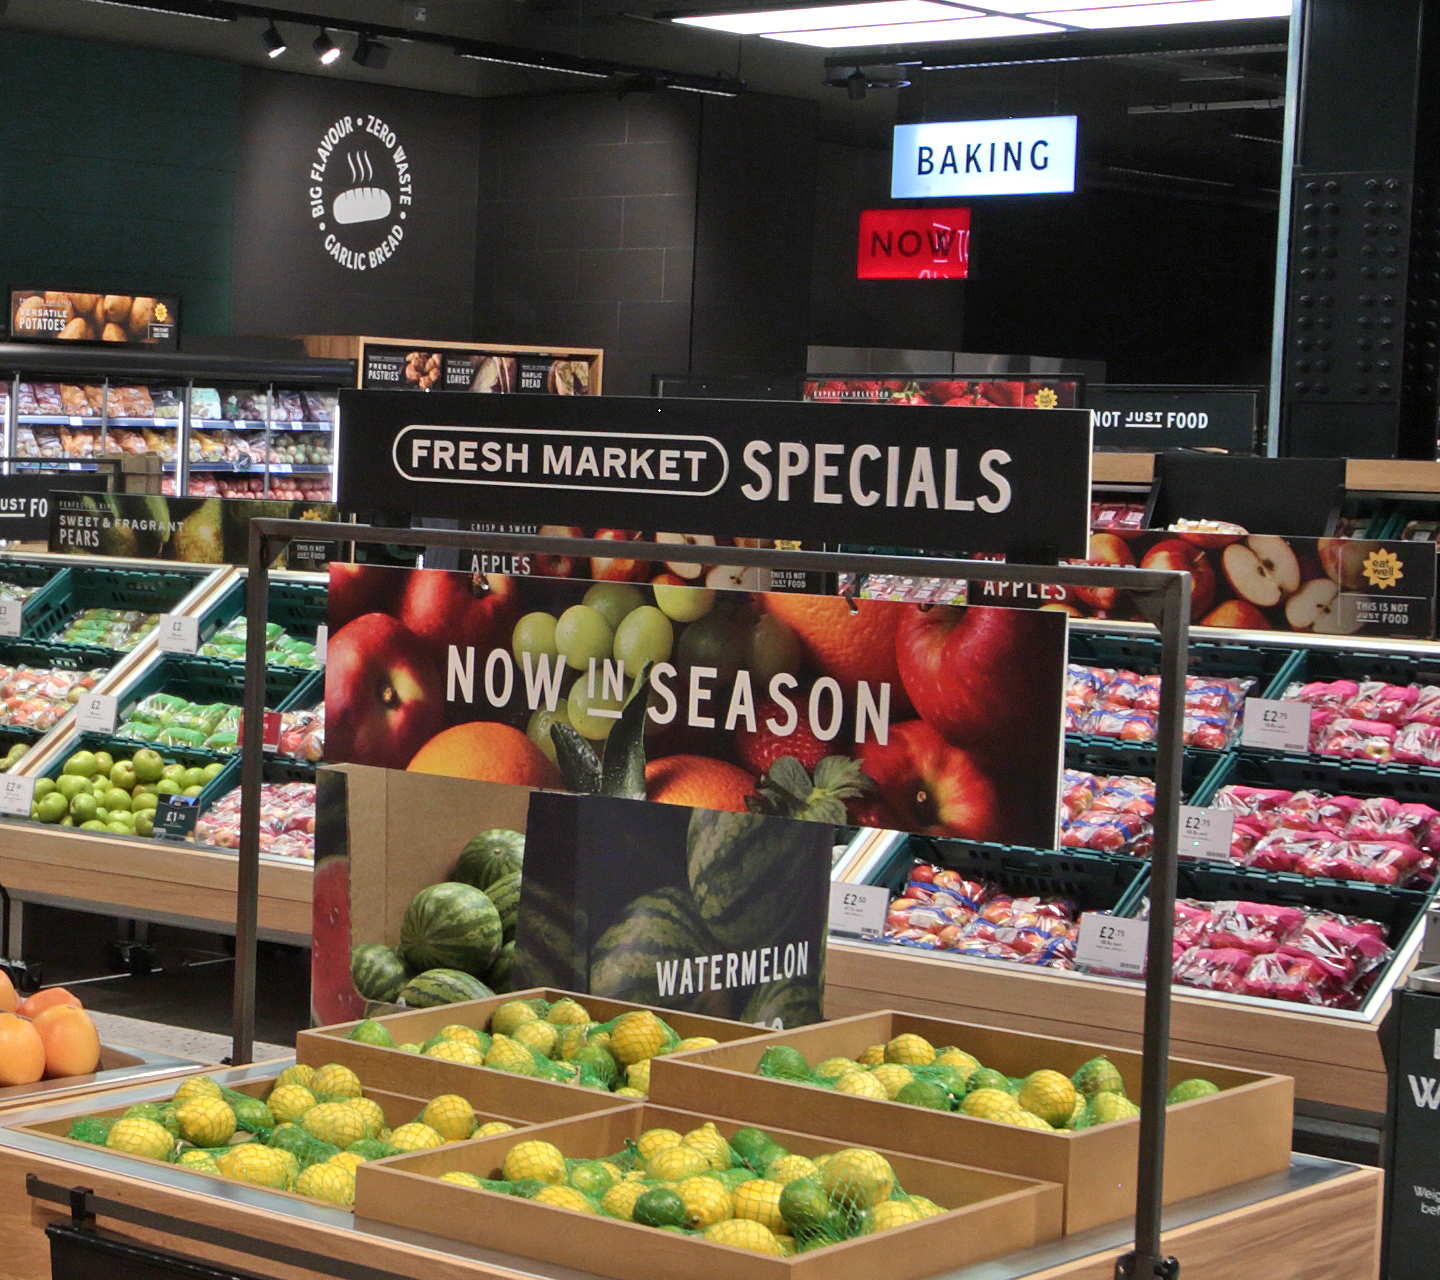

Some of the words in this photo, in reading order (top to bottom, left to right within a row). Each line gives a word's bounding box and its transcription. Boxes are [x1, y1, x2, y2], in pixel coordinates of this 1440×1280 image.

[310, 115, 354, 182] FLAVOUR
[916, 139, 1050, 176] BAKING
[366, 114, 397, 148] ZERO
[392, 145, 412, 206] WASTE
[309, 186, 325, 219] BIG
[324, 234, 367, 271] GARLIC
[368, 224, 404, 269] BREAD
[870, 228, 957, 259] NOW
[19, 308, 68, 318] VERSATILE
[19, 317, 66, 331] POTATOES
[368, 369, 400, 382] PASTRIES
[447, 374, 470, 385] LOAVES
[522, 378, 541, 389] BREAD
[1092, 411, 1120, 427] NOT
[1125, 411, 1162, 423] JUST
[1167, 411, 1208, 429] FOOD
[410, 437, 530, 475] FRESH
[542, 442, 707, 483] MARKET
[740, 438, 1013, 514] SPECIALS
[59, 515, 99, 528] SWEET
[102, 517, 113, 529] &
[115, 518, 184, 533] FRAGRANT
[470, 522, 501, 532] CRISP
[509, 524, 538, 534] SWEET
[59, 528, 100, 548] PEARS
[470, 553, 532, 575] APPLES
[1371, 557, 1390, 568] eat
[1373, 566, 1395, 577] well
[983, 578, 1067, 601] APPLES
[1355, 601, 1378, 613] THIS
[1378, 602, 1388, 613] IS
[1389, 602, 1409, 614] NOT
[1355, 611, 1379, 621] JUST
[1381, 612, 1409, 625] FOOD
[446, 644, 567, 714] NOW
[586, 656, 624, 702] IN
[646, 661, 892, 747] SEASON
[655, 940, 810, 998] WATERMELON
